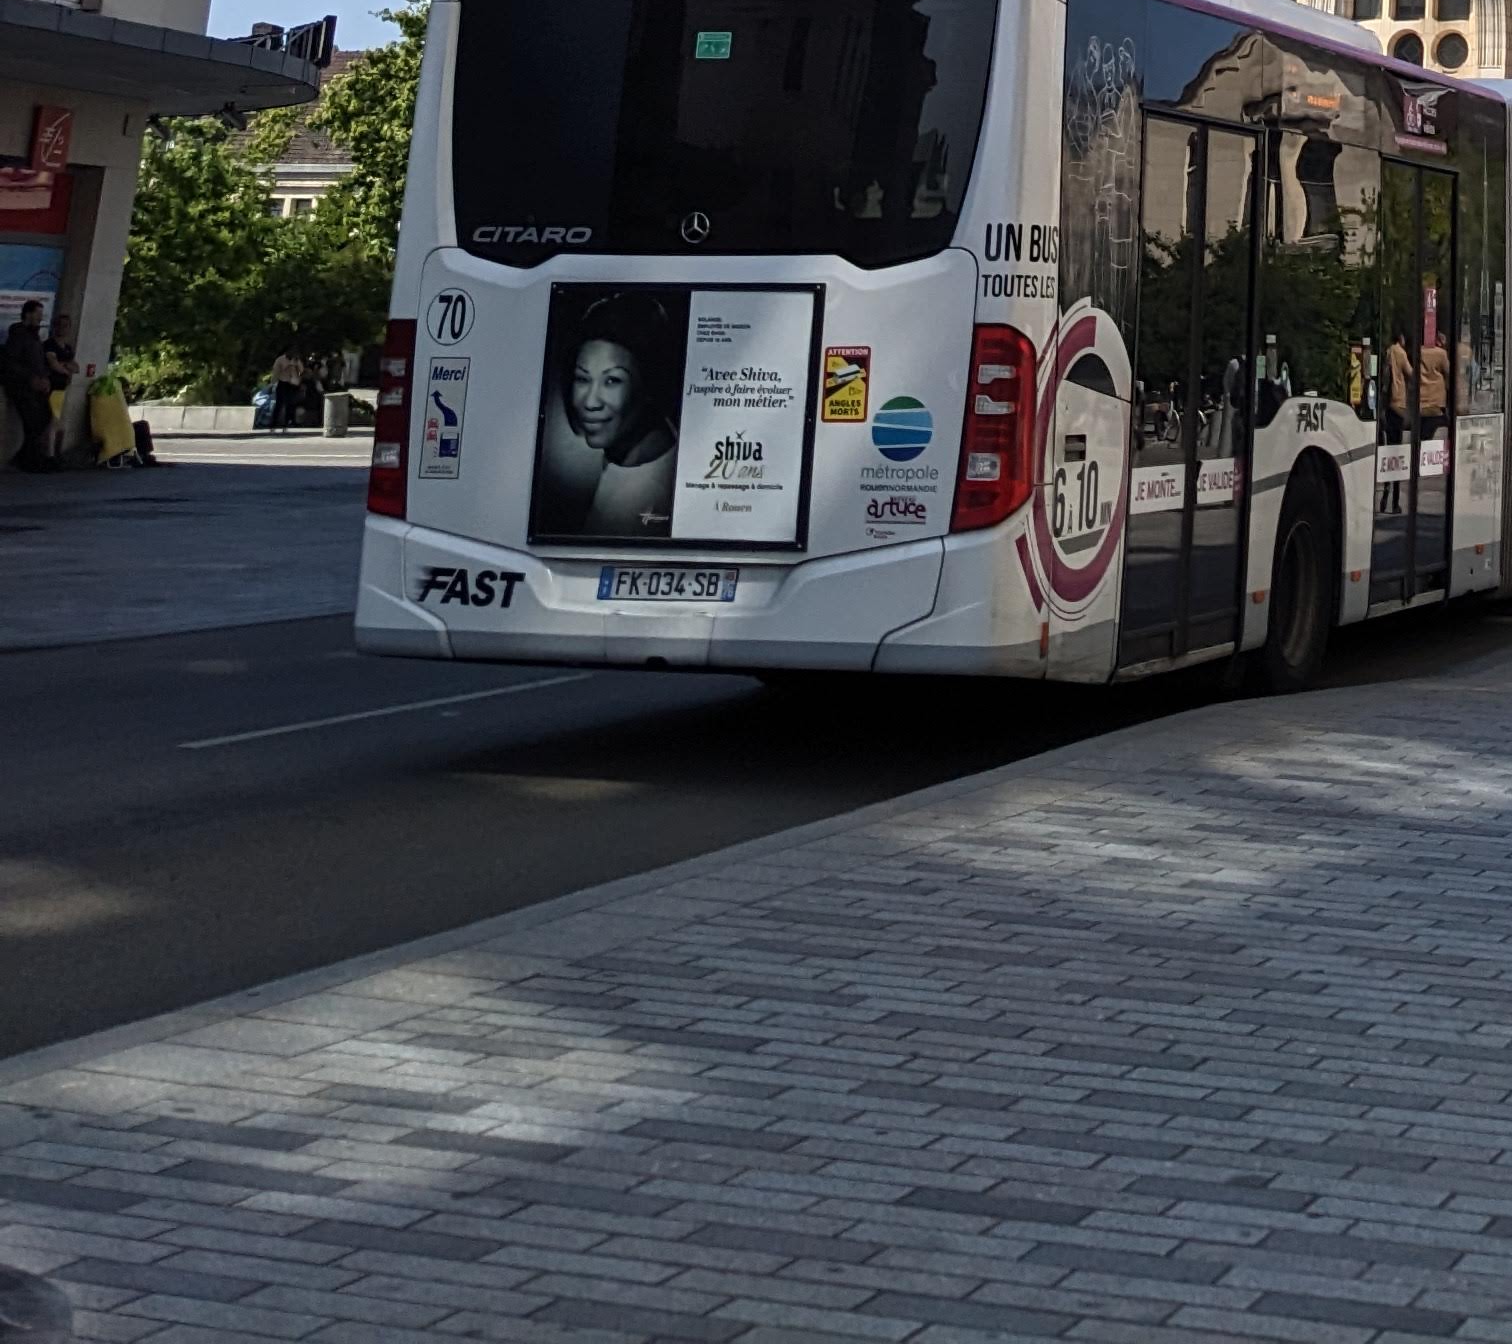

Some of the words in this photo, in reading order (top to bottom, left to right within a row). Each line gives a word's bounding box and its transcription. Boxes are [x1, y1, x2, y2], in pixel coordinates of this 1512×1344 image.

[472, 226, 593, 243] CITARO
[984, 222, 1023, 262] UN
[1029, 224, 1058, 264] BUS
[981, 273, 1038, 298] TOUTES
[1040, 275, 1055, 299] LES
[437, 294, 466, 340] 70
[827, 348, 868, 356] ATTENTION
[432, 366, 466, 381] Merci
[725, 384, 731, 394] à
[730, 383, 755, 396] faire
[757, 384, 792, 395] évoluer
[713, 397, 740, 407] mon
[829, 400, 861, 408] ANGLES
[830, 407, 860, 416] MORTS
[1296, 402, 1327, 433] FAST
[714, 431, 763, 461] shiva
[704, 457, 738, 480] 20
[861, 464, 939, 483] métropole
[1134, 481, 1145, 502] JE
[1197, 473, 1207, 492] JE
[721, 501, 752, 512] Rouen
[867, 497, 927, 519] astuce
[1052, 467, 1066, 538] 6
[1077, 460, 1098, 531] 10
[416, 565, 526, 608] FAST
[615, 571, 720, 597] FK-034-SB
